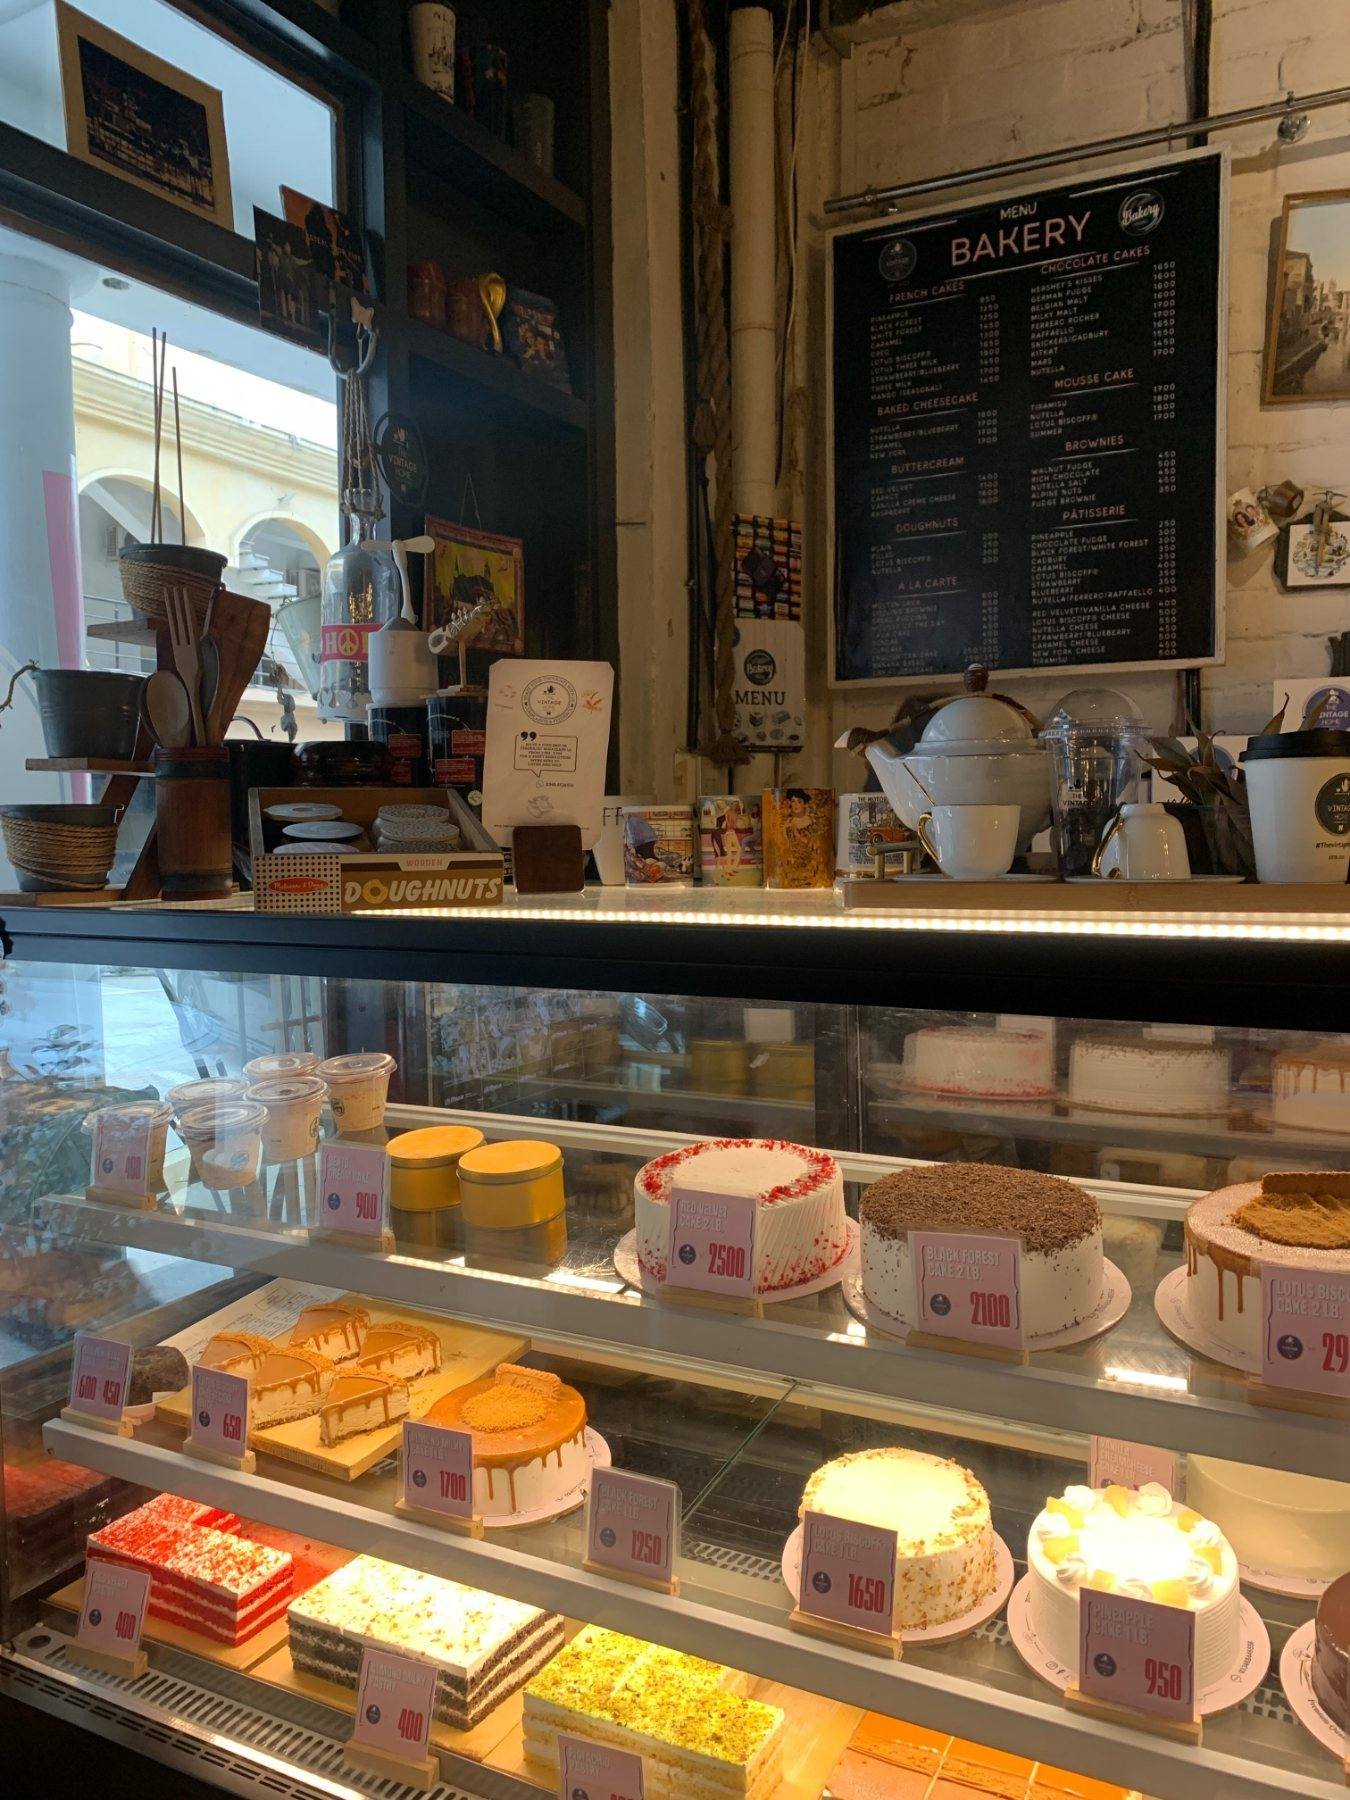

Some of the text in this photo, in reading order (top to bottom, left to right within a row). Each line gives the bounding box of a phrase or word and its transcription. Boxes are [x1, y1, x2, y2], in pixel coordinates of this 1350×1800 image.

[1000, 202, 1037, 220] MENU
[1122, 203, 1160, 226] Bakery
[951, 211, 1091, 267] BAKERY
[1041, 245, 1150, 274] CHOCOLATE CAKES
[889, 281, 965, 303] FRENCH CAKES
[1067, 296, 1088, 305] MALT
[1056, 307, 1076, 316] MALT
[1054, 368, 1134, 388] MOUSSE CAKE
[877, 392, 977, 415] BAKED CHEESECAKE
[1065, 435, 1124, 451] BROWNIES
[388, 455, 417, 472] VINTAGE
[891, 455, 964, 473] BUTTERCREAM
[1053, 469, 1099, 480] CHOCOLATE
[896, 517, 958, 533] DOUGHNUTS
[1031, 538, 1078, 548] CHOCOLATE
[1031, 548, 1055, 556] BLACK
[1119, 539, 1148, 548] FOREST
[1031, 563, 1067, 572] CARAMEL
[924, 576, 957, 588] CARTE
[1100, 612, 1129, 620] CHEESE
[1119, 602, 1150, 610] CHEESE
[735, 690, 786, 705] MENU
[406, 858, 443, 867] WOODEN
[344, 877, 501, 904] DOUGHNUTS
[356, 1191, 377, 1220] 900
[680, 1199, 696, 1213] RED
[680, 1214, 702, 1229] CAKE
[708, 1242, 745, 1278] 2500
[926, 1246, 1000, 1266] BLACK FOREST
[927, 1262, 964, 1279] CAKE 2
[1276, 1278, 1313, 1298] LOTUS
[970, 1291, 1010, 1328] 2100
[1276, 1297, 1308, 1314] CAKE
[1312, 1301, 1321, 1316] 2
[78, 1374, 121, 1406] 600 450
[223, 1412, 242, 1440] 650
[440, 1470, 466, 1501] 1700
[600, 1483, 627, 1502] BLACK
[629, 1491, 660, 1510] FOREST
[631, 1528, 662, 1565] 1250
[848, 1573, 885, 1614] 1650
[115, 1610, 137, 1640] 400
[1093, 1602, 1154, 1630] PINEAPPLE
[1094, 1617, 1122, 1639] CAKE
[1145, 1658, 1182, 1701] 950
[398, 1708, 424, 1742] 400
